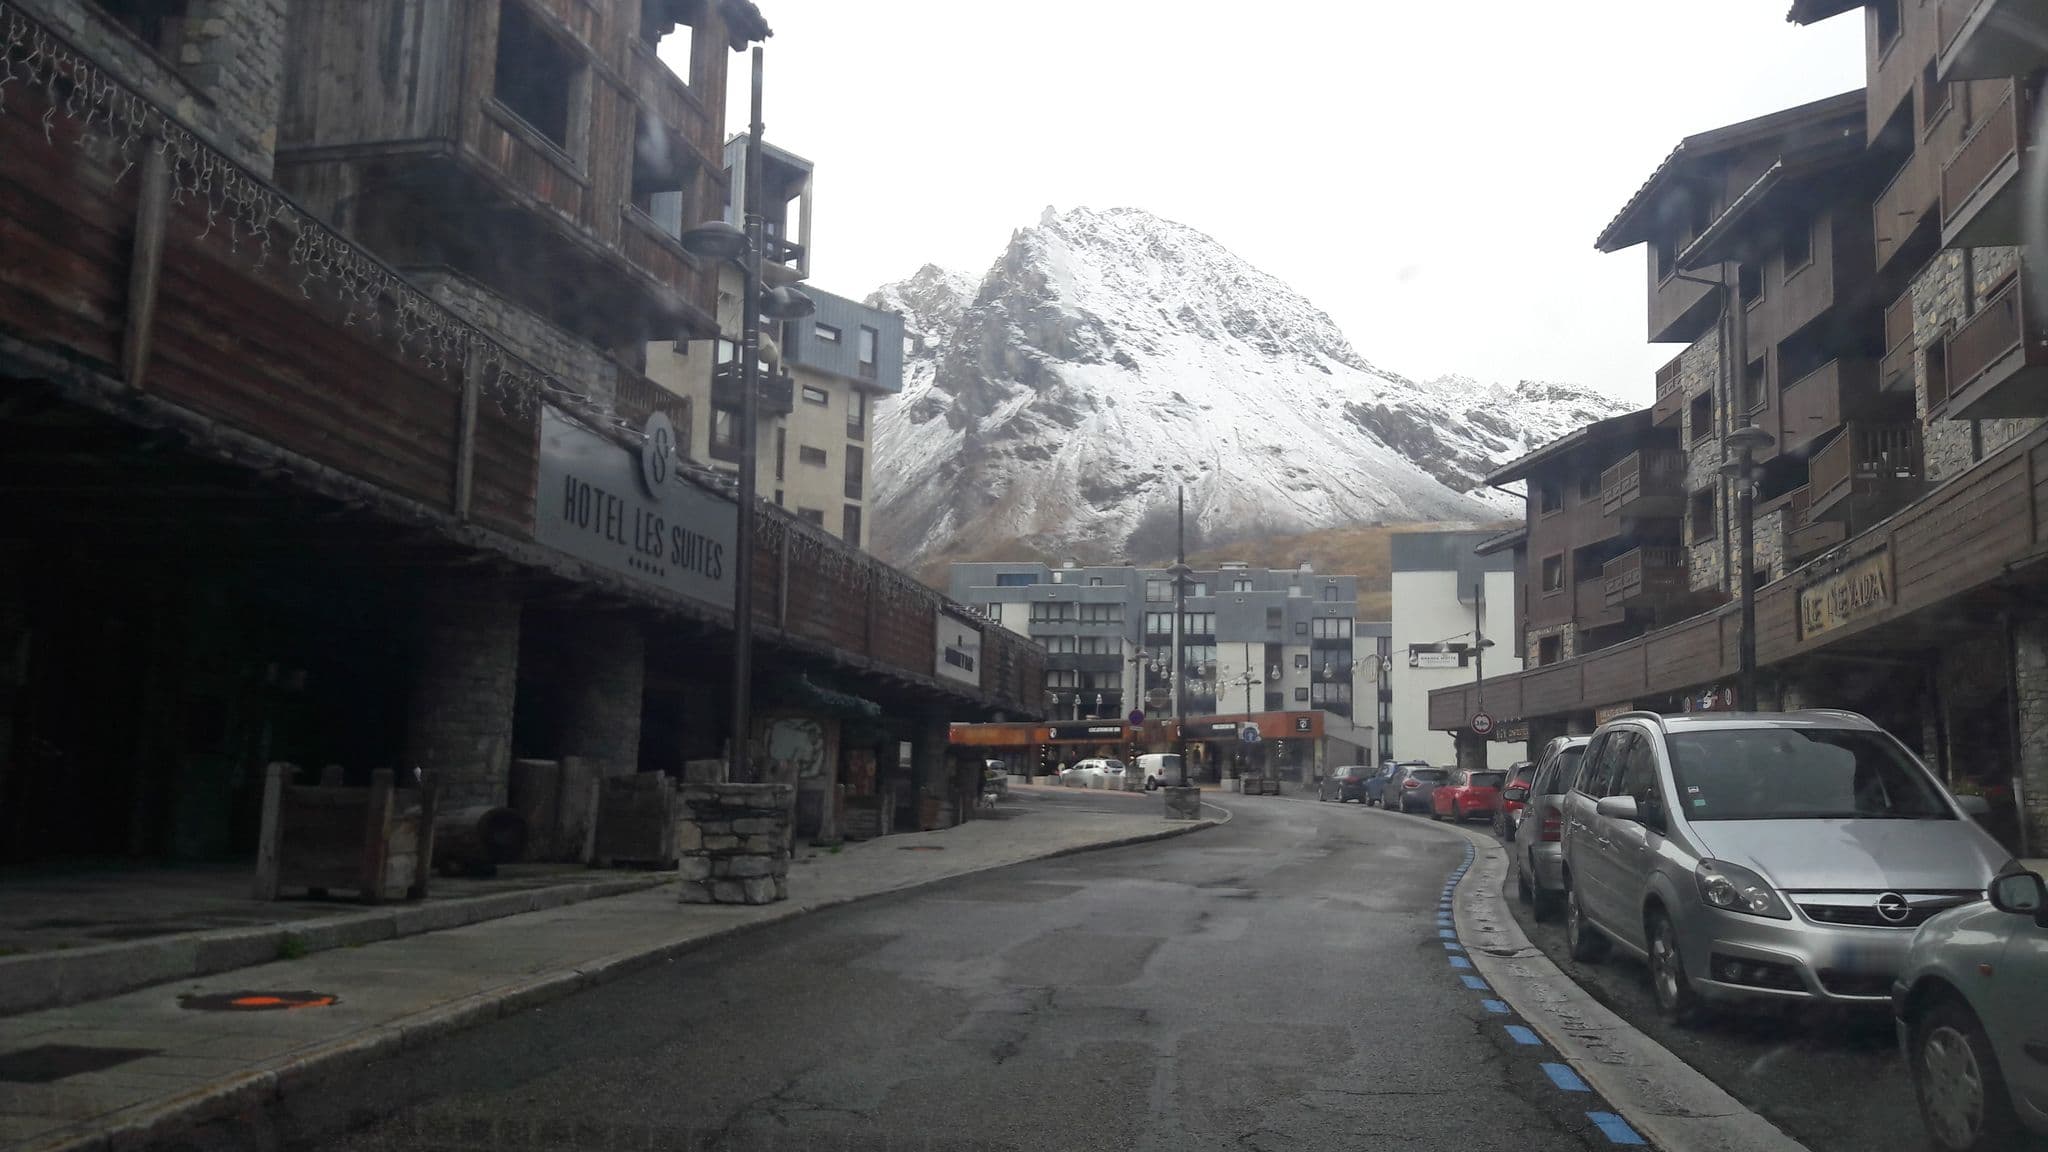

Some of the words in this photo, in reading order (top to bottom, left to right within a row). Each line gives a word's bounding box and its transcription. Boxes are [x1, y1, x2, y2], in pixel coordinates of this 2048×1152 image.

[564, 474, 627, 545] HOTEL
[634, 506, 664, 559] LES
[671, 524, 723, 581] SUITES
[1801, 591, 1825, 633] LE
[1826, 561, 1888, 623] NEVADA
